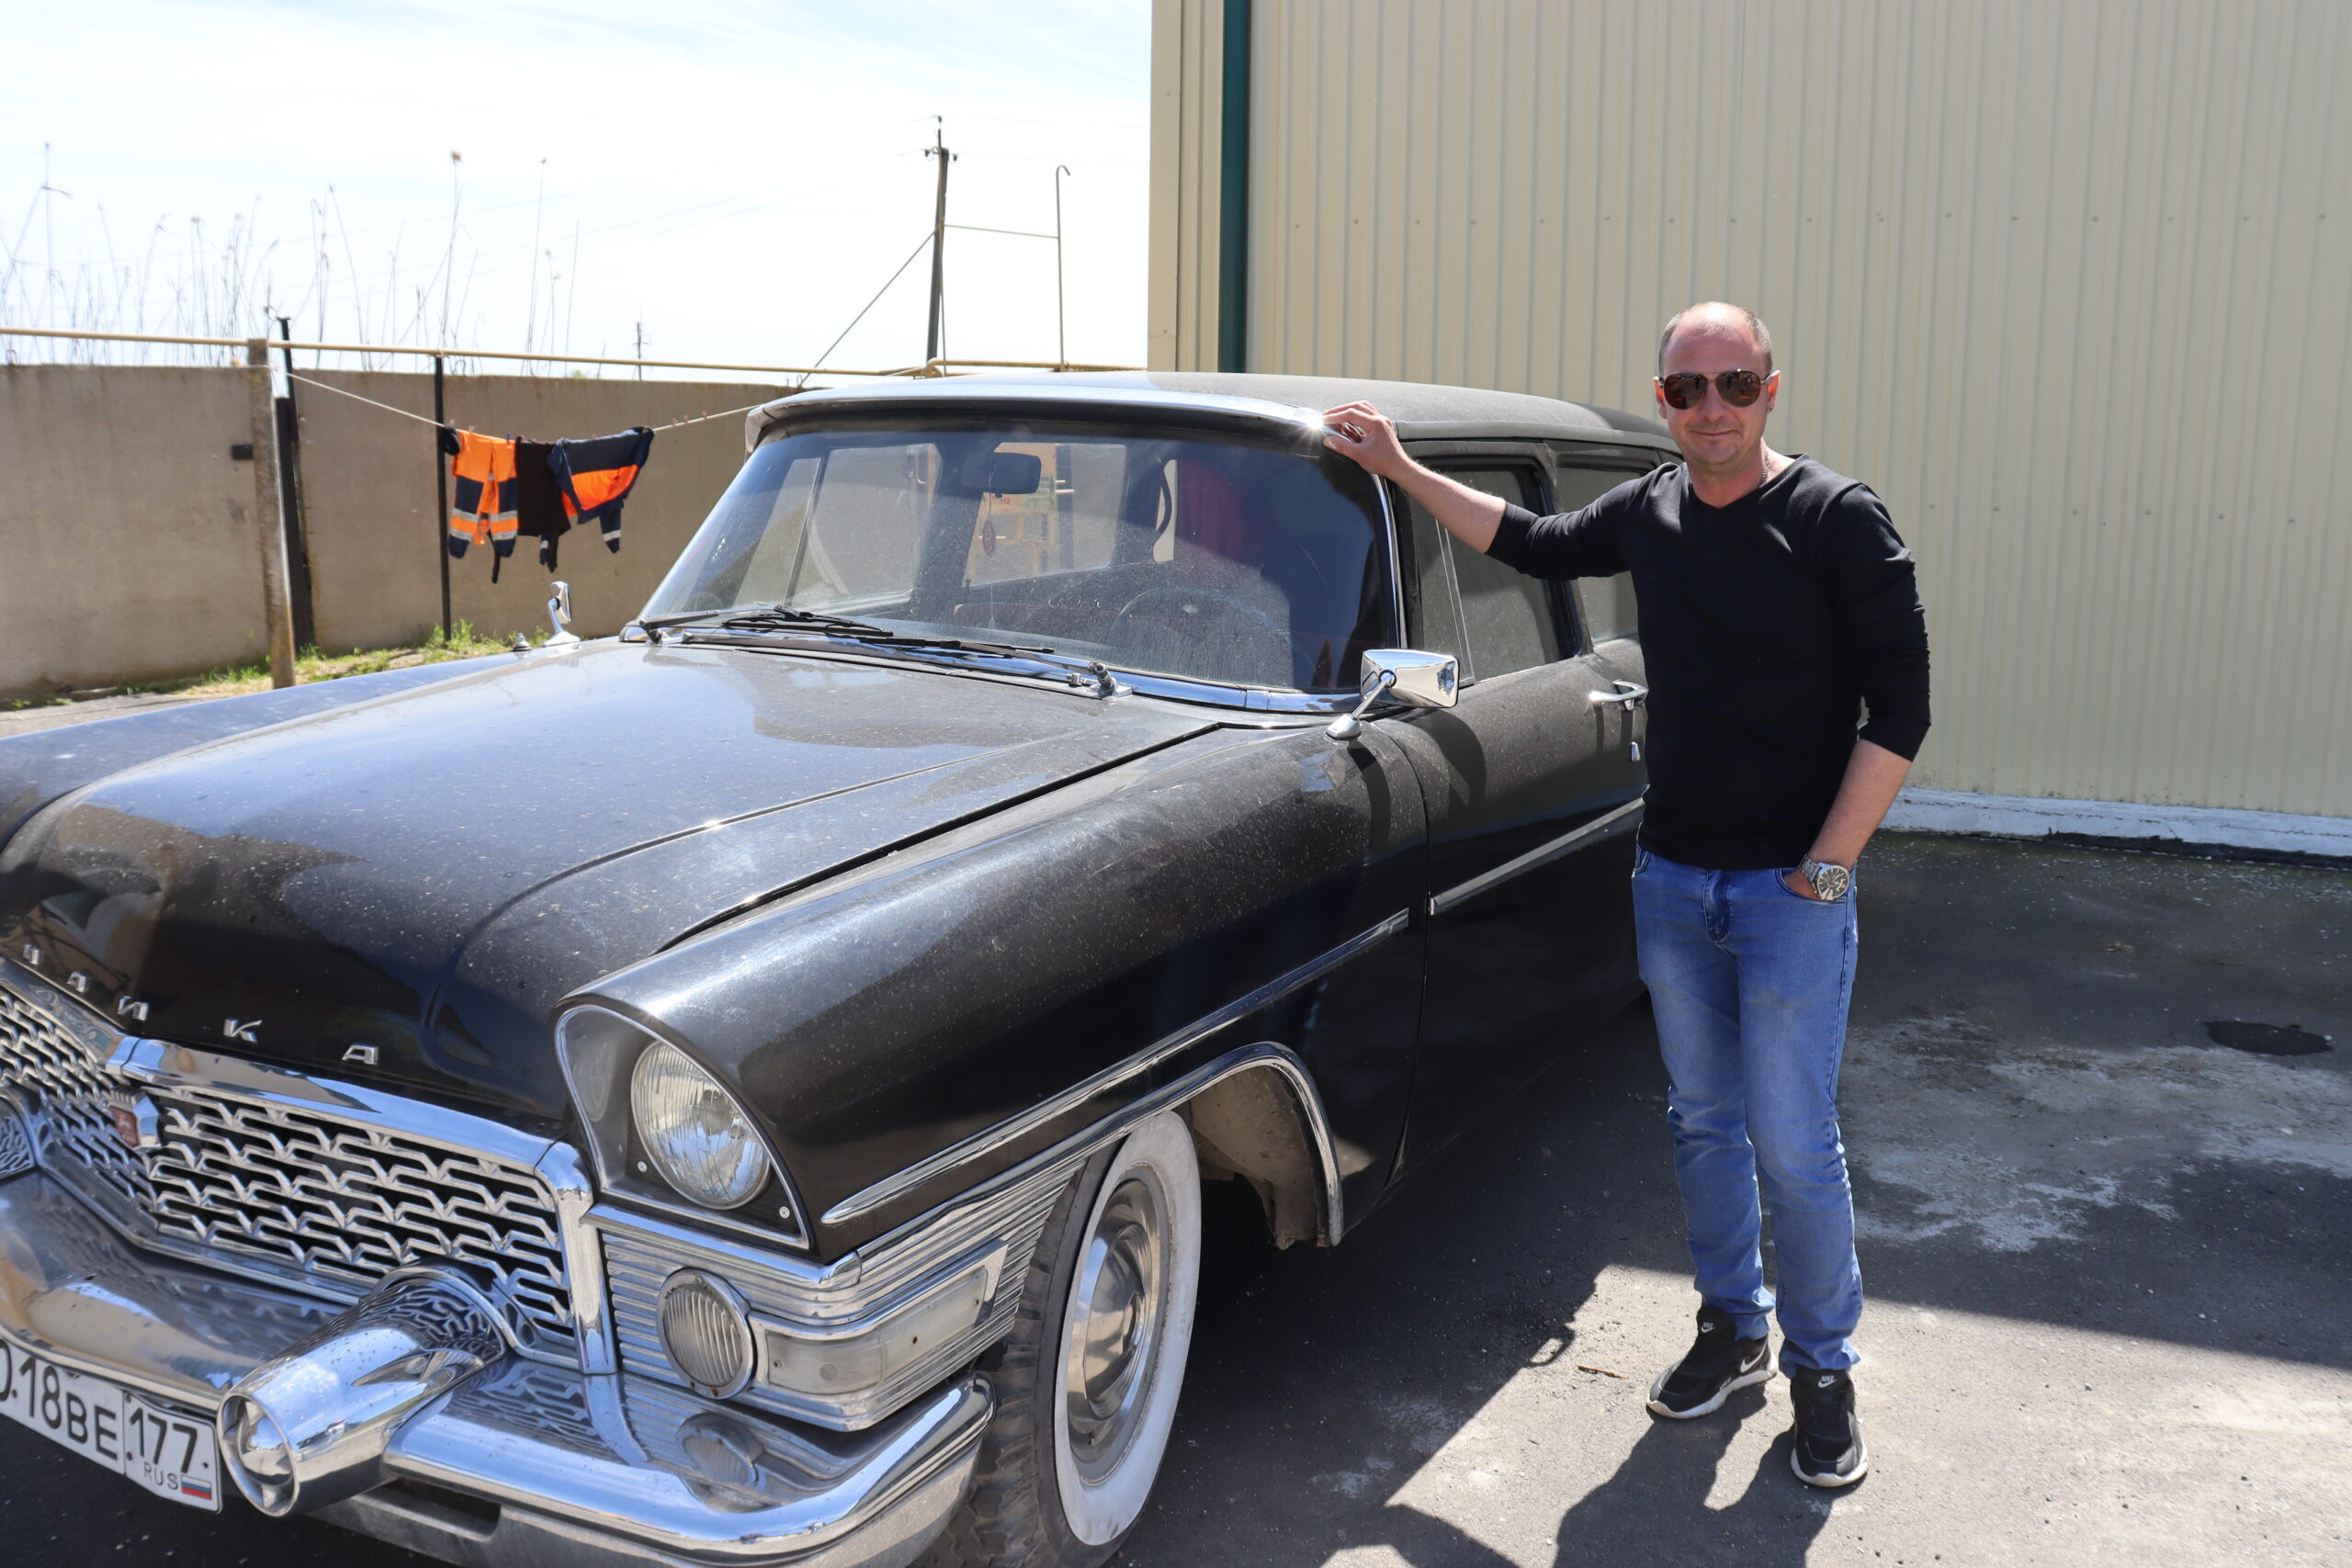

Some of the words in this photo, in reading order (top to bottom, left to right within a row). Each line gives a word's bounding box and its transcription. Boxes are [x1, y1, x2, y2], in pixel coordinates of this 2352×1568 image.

[1821, 1374, 1835, 1382] NIKE
[130, 1407, 198, 1474] 177
[144, 1461, 179, 1490] RUS
